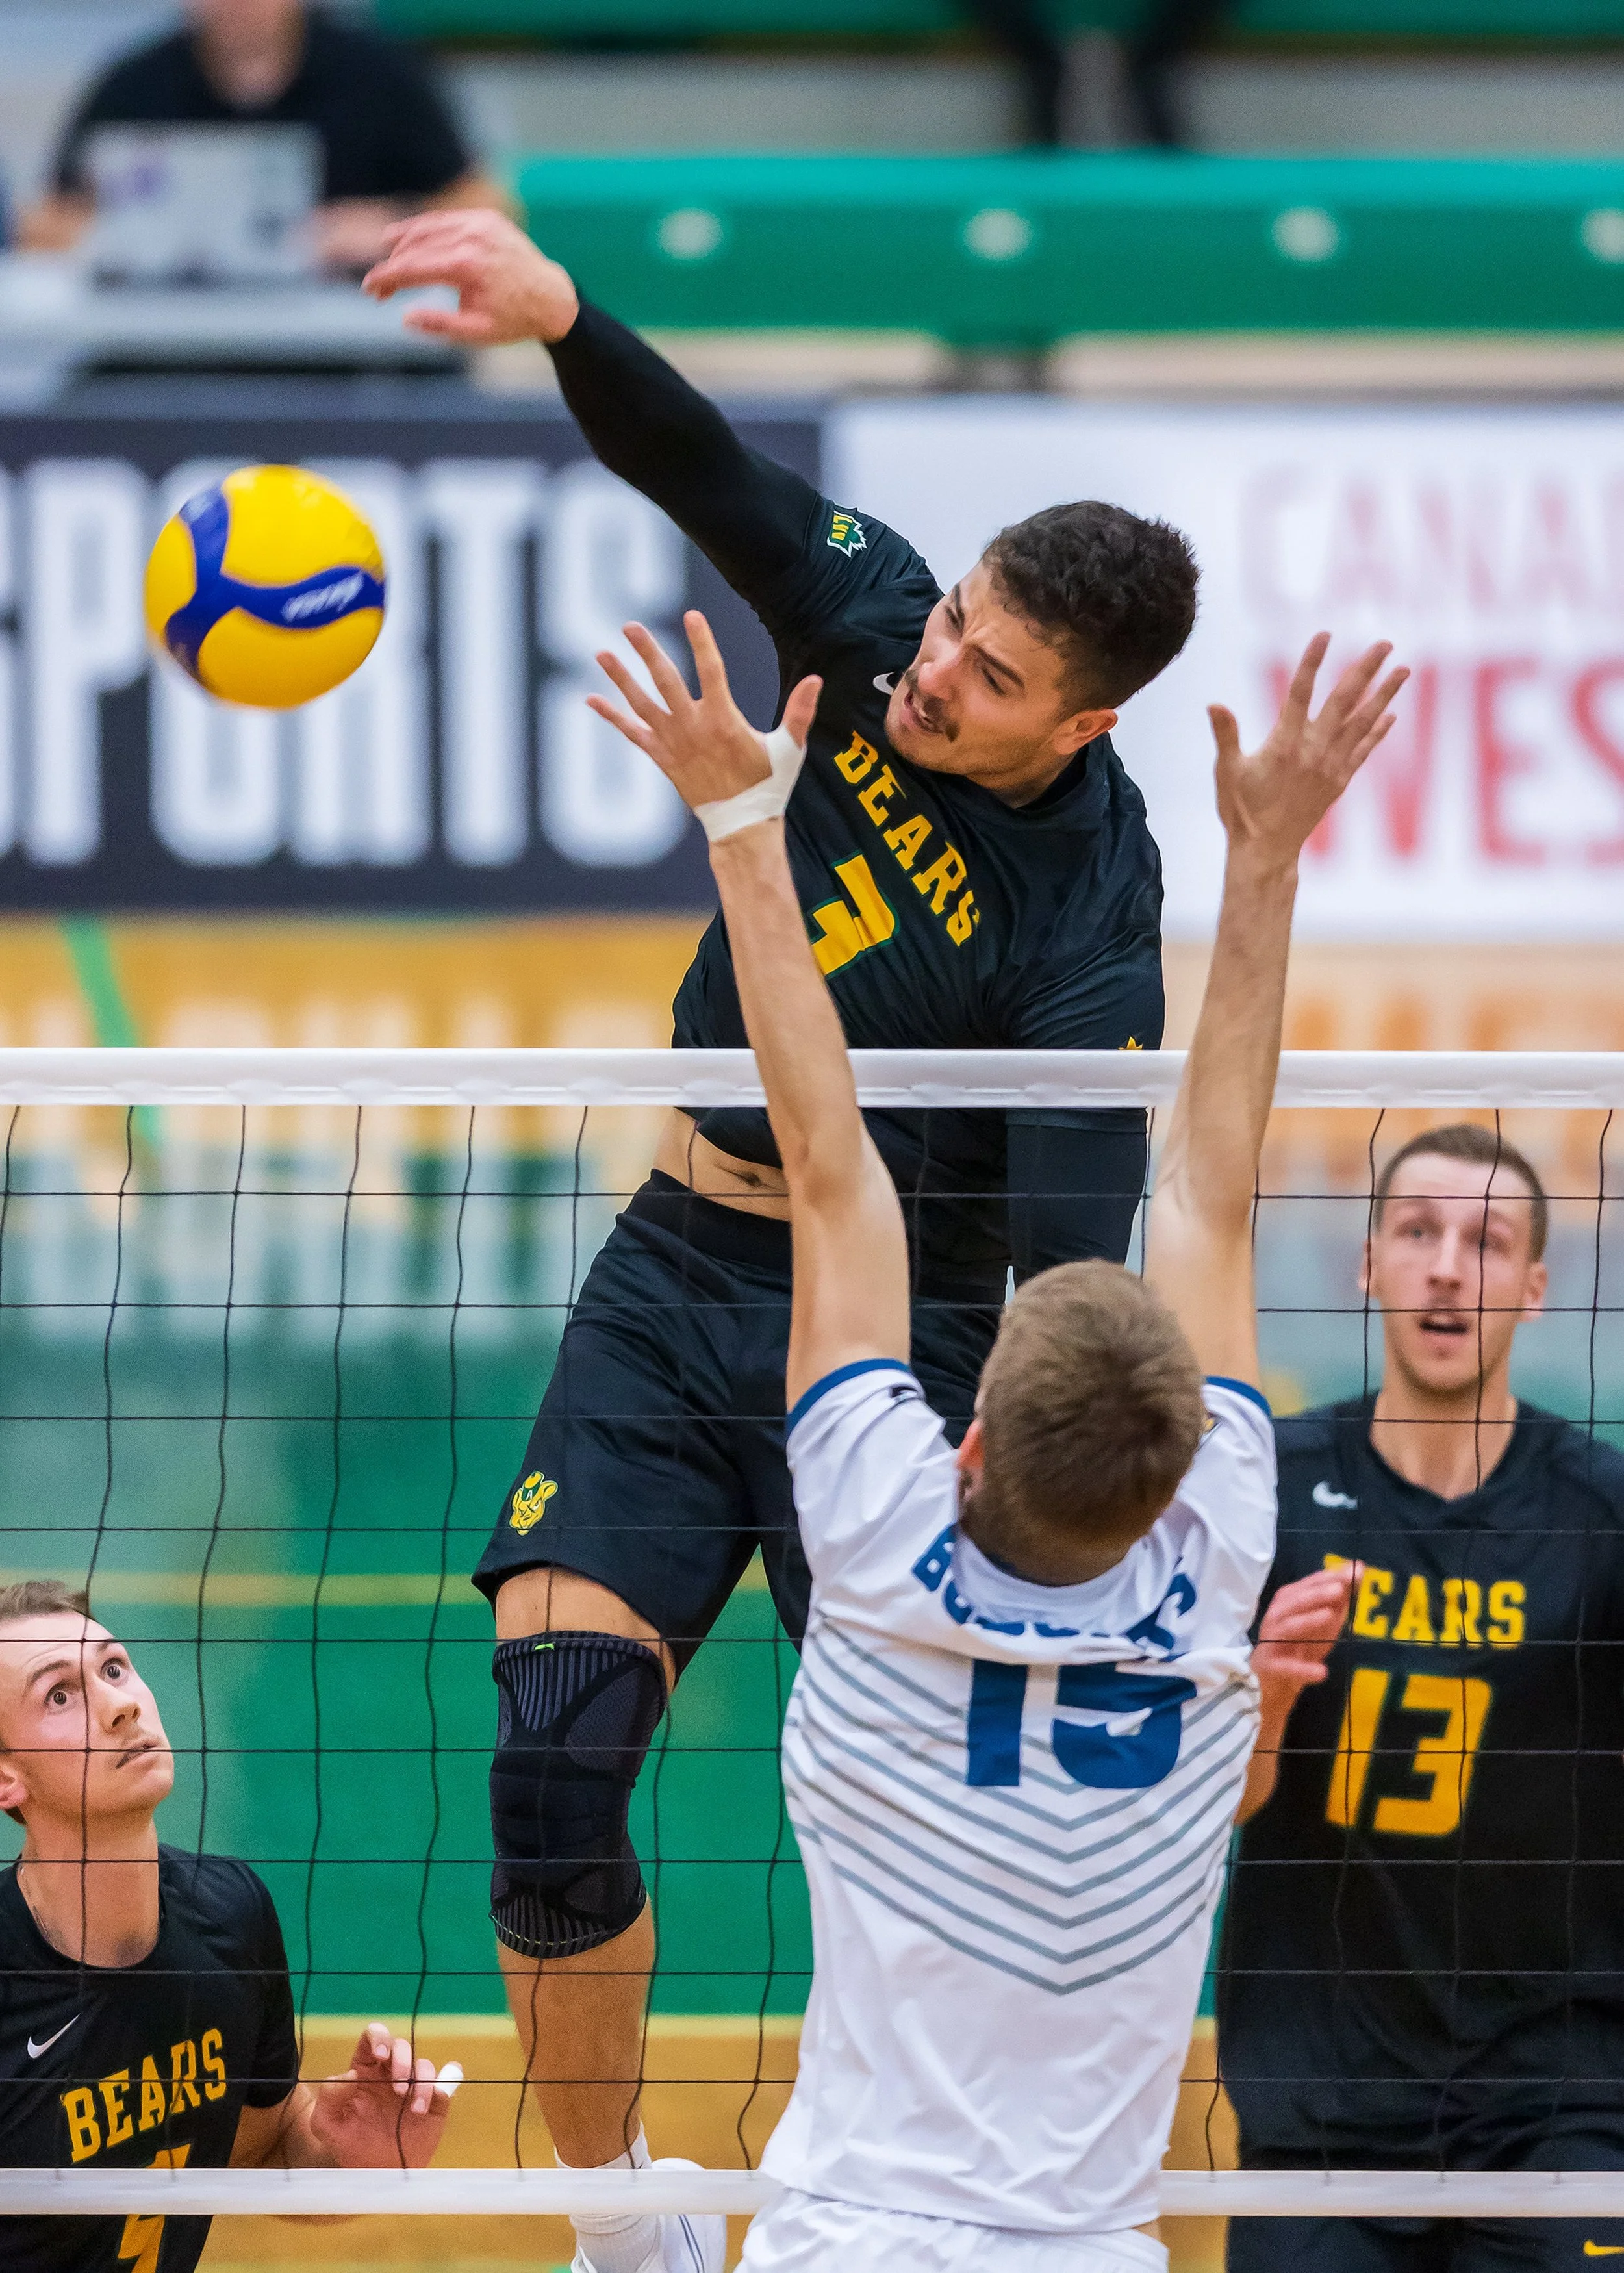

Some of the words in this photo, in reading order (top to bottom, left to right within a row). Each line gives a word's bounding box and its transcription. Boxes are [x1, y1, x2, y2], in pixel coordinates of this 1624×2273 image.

[1239, 465, 1624, 614] CANA
[0, 458, 687, 865] PORTS
[833, 730, 981, 946] BEARS
[1324, 1553, 1527, 1650] EARS
[966, 1659, 1197, 1788] 15
[1325, 1668, 1491, 1836] 13
[60, 2028, 227, 2163] BEARS
